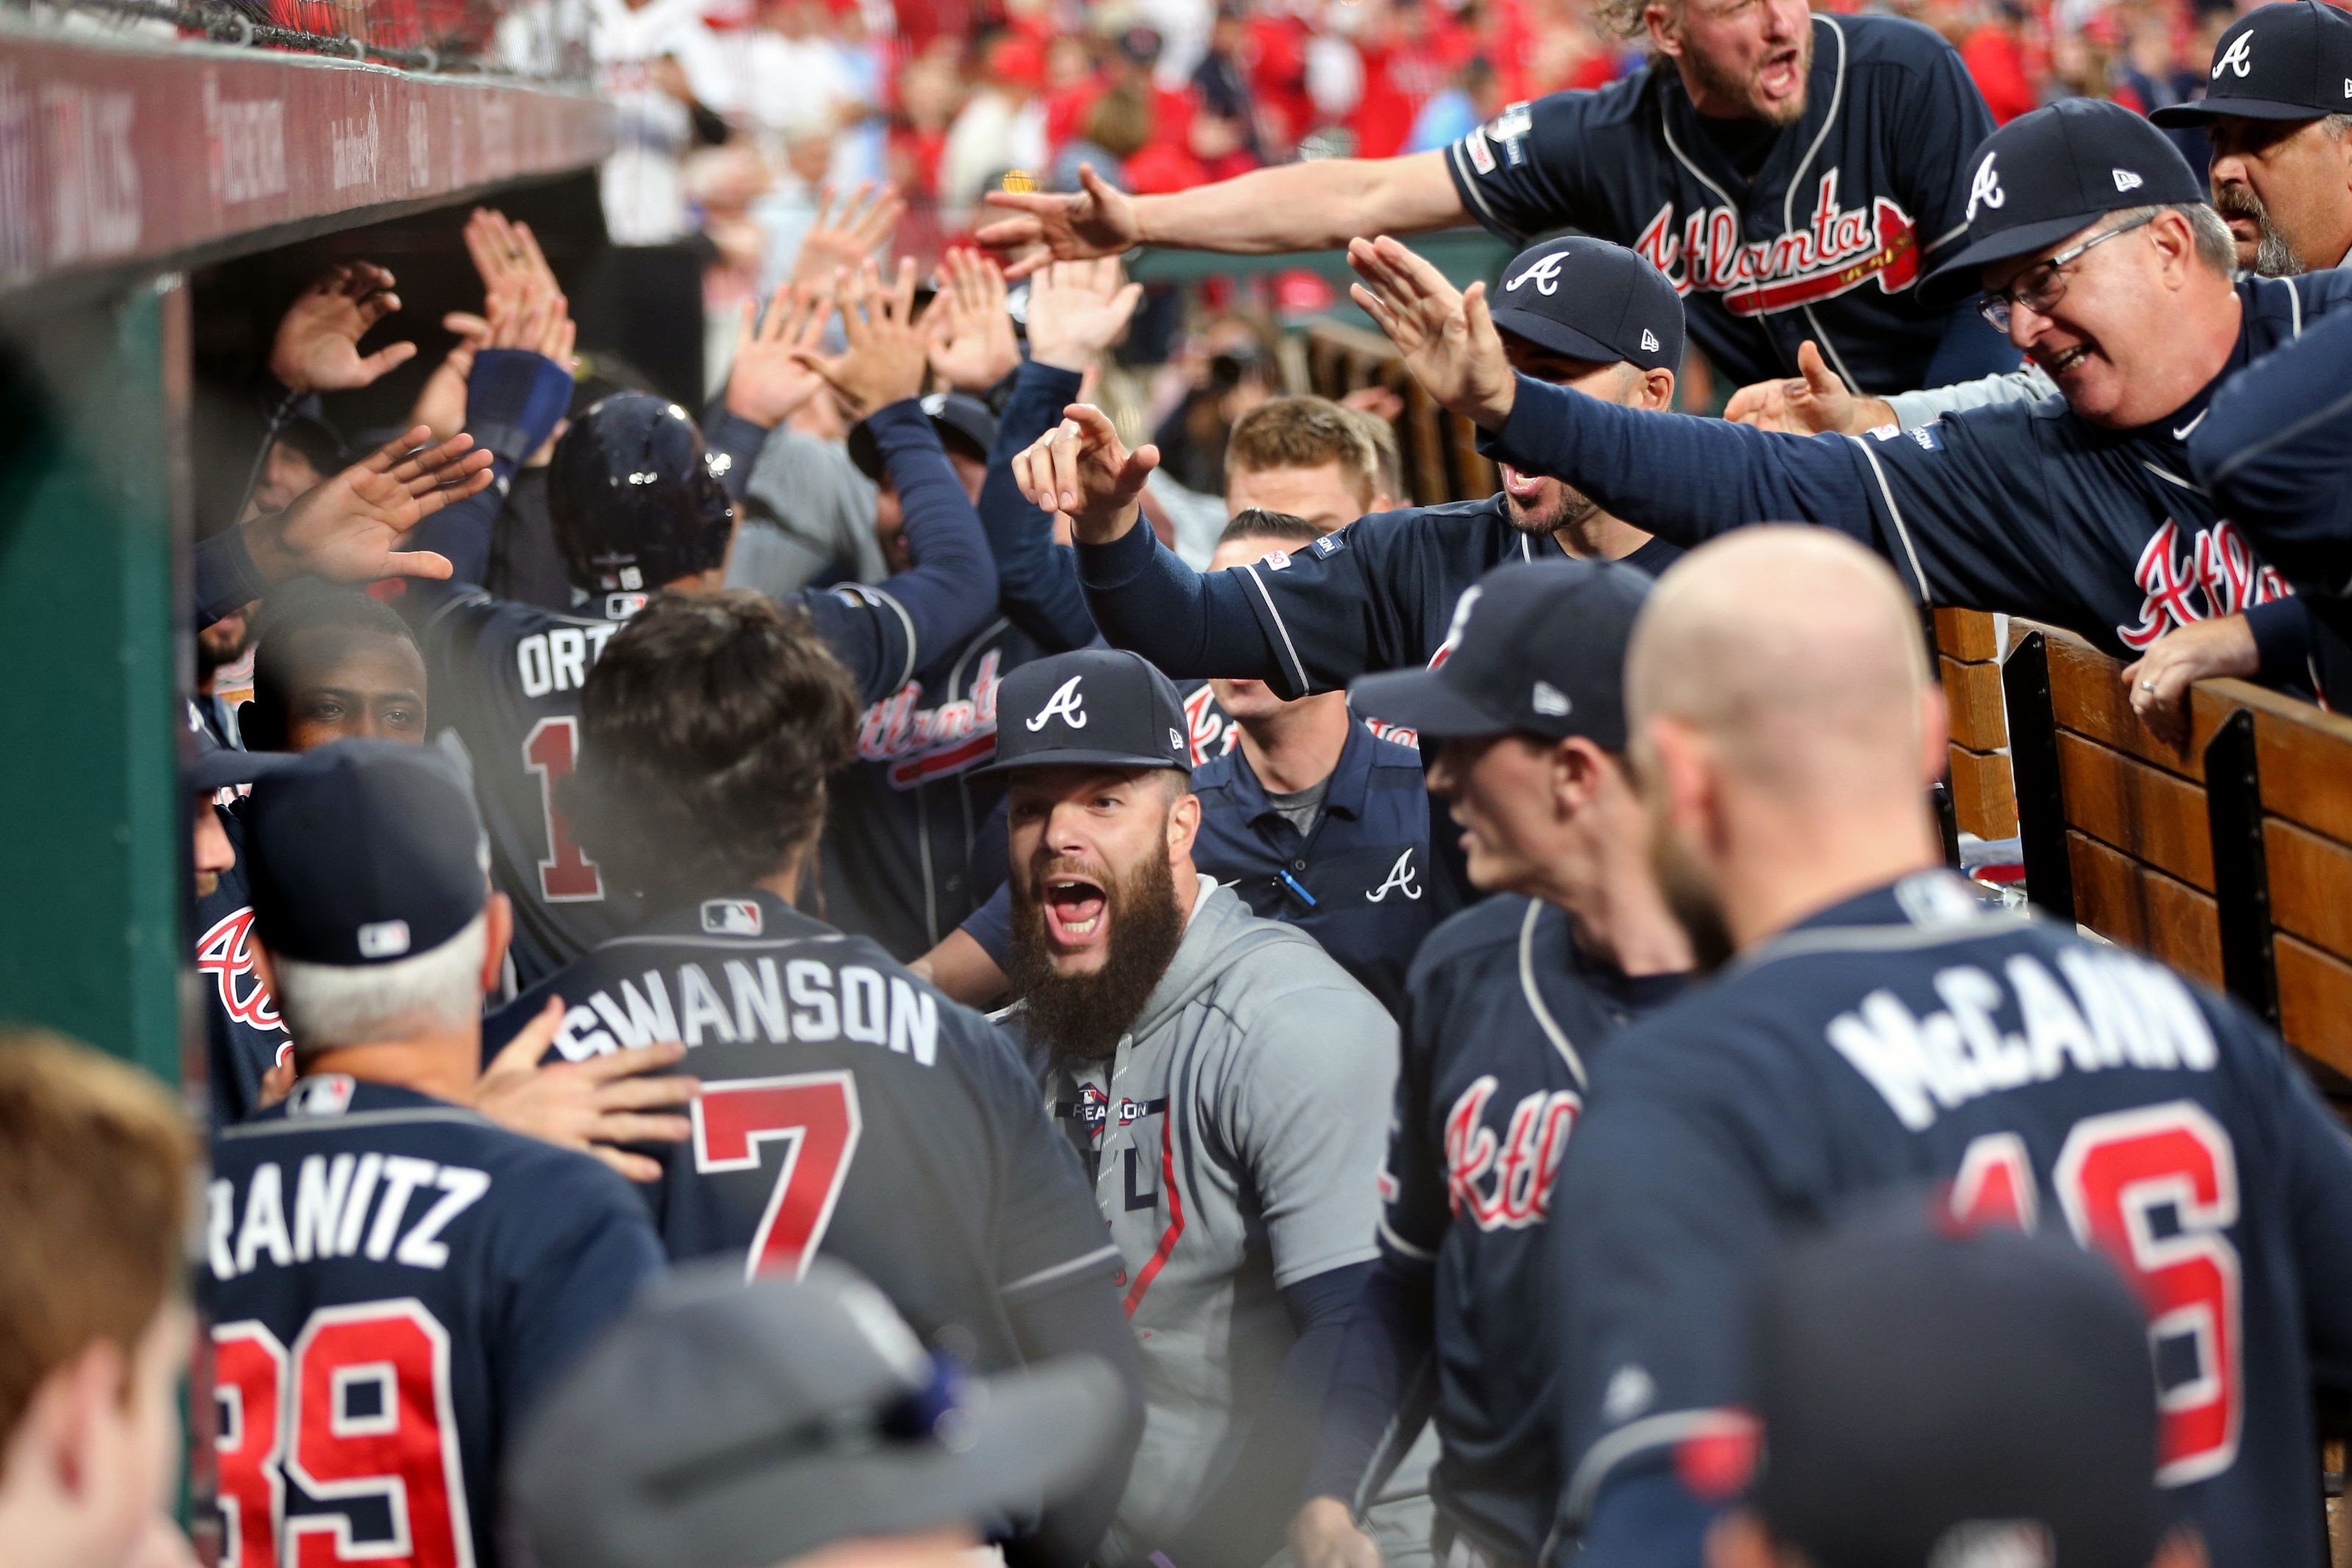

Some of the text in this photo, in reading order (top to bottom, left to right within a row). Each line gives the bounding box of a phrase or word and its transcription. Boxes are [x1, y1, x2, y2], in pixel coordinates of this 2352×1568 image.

[1633, 167, 1871, 300] Atlanta
[1026, 675, 1087, 732] A
[1366, 847, 1422, 902] A
[549, 957, 939, 1067] SWANSON
[1072, 1102, 1147, 1123] EAON
[690, 1069, 863, 1284] 7
